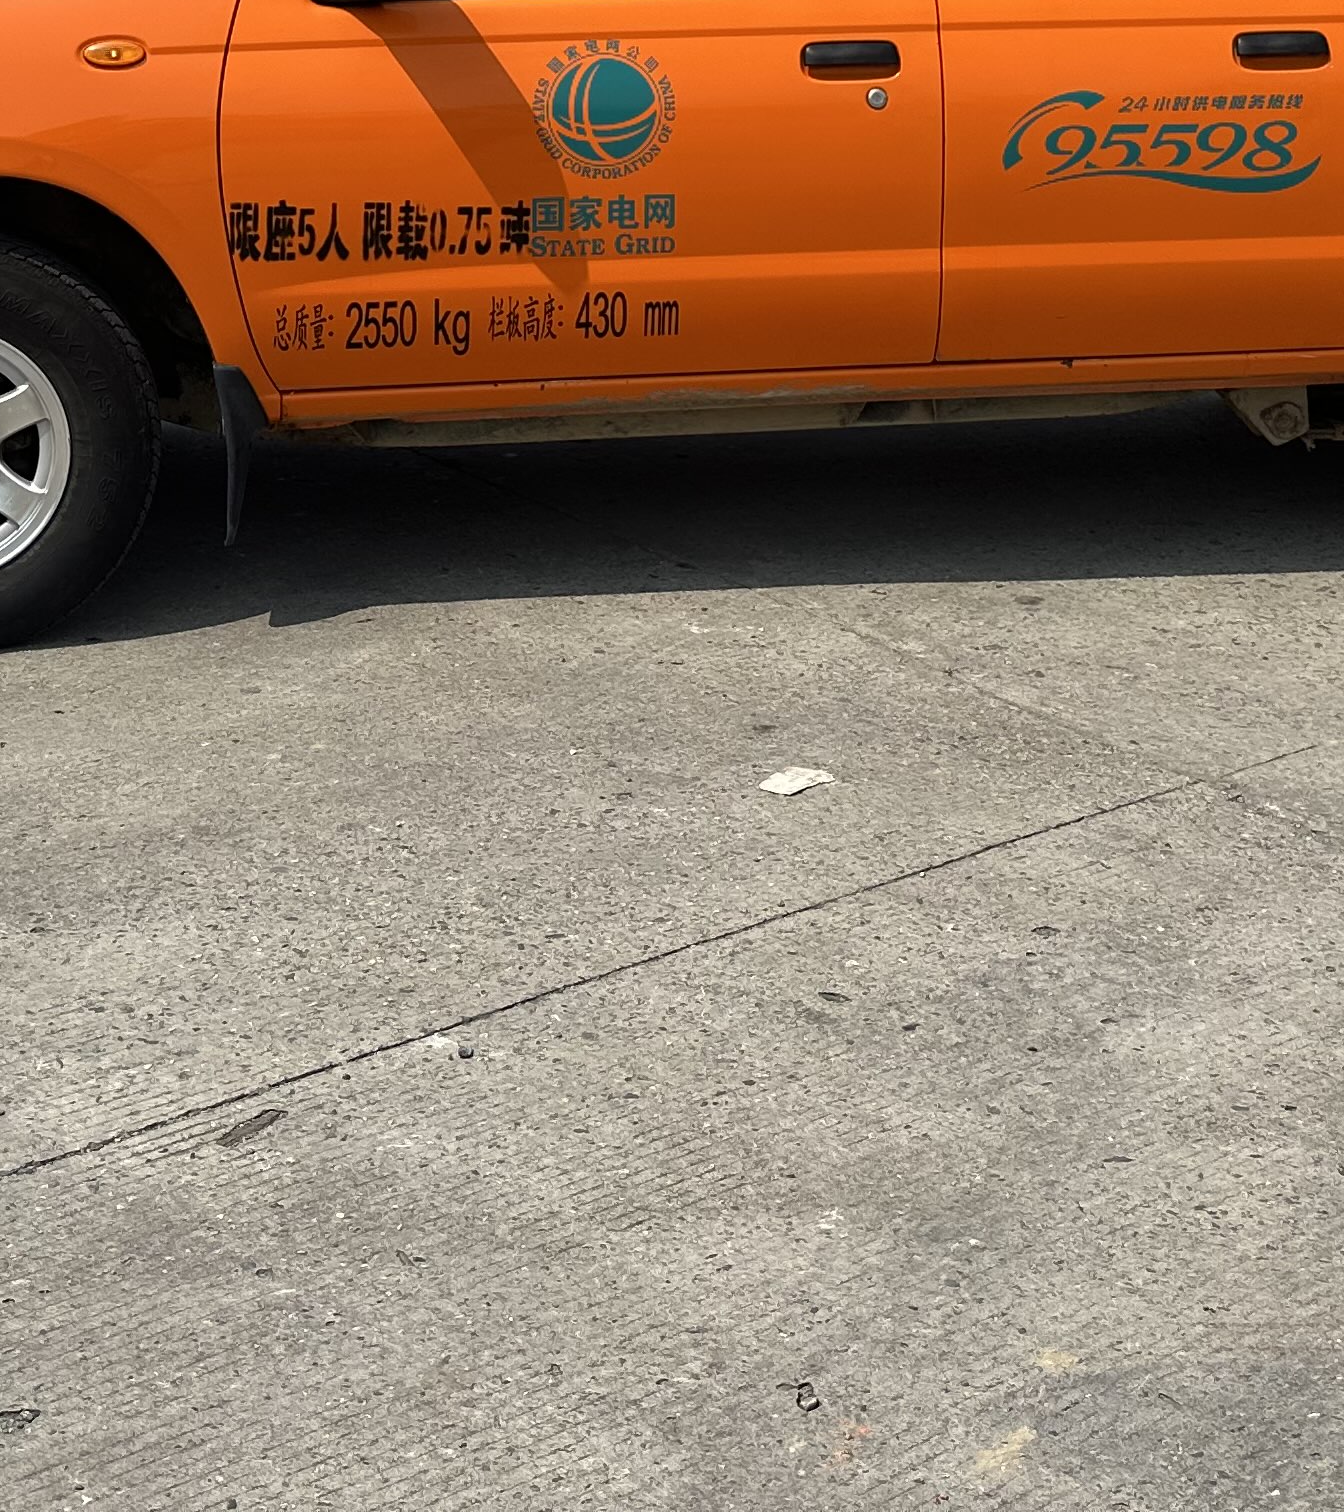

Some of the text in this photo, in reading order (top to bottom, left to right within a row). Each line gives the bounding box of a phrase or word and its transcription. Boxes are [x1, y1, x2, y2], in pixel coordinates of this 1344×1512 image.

[561, 143, 662, 180] CORPORATION
[1045, 119, 1298, 175] 95598
[532, 194, 676, 233] 国家电网
[529, 233, 676, 257] STATE GRID
[344, 299, 418, 350] 2550
[433, 297, 471, 356] kg
[574, 291, 628, 340] 430
[642, 298, 680, 337] mm
